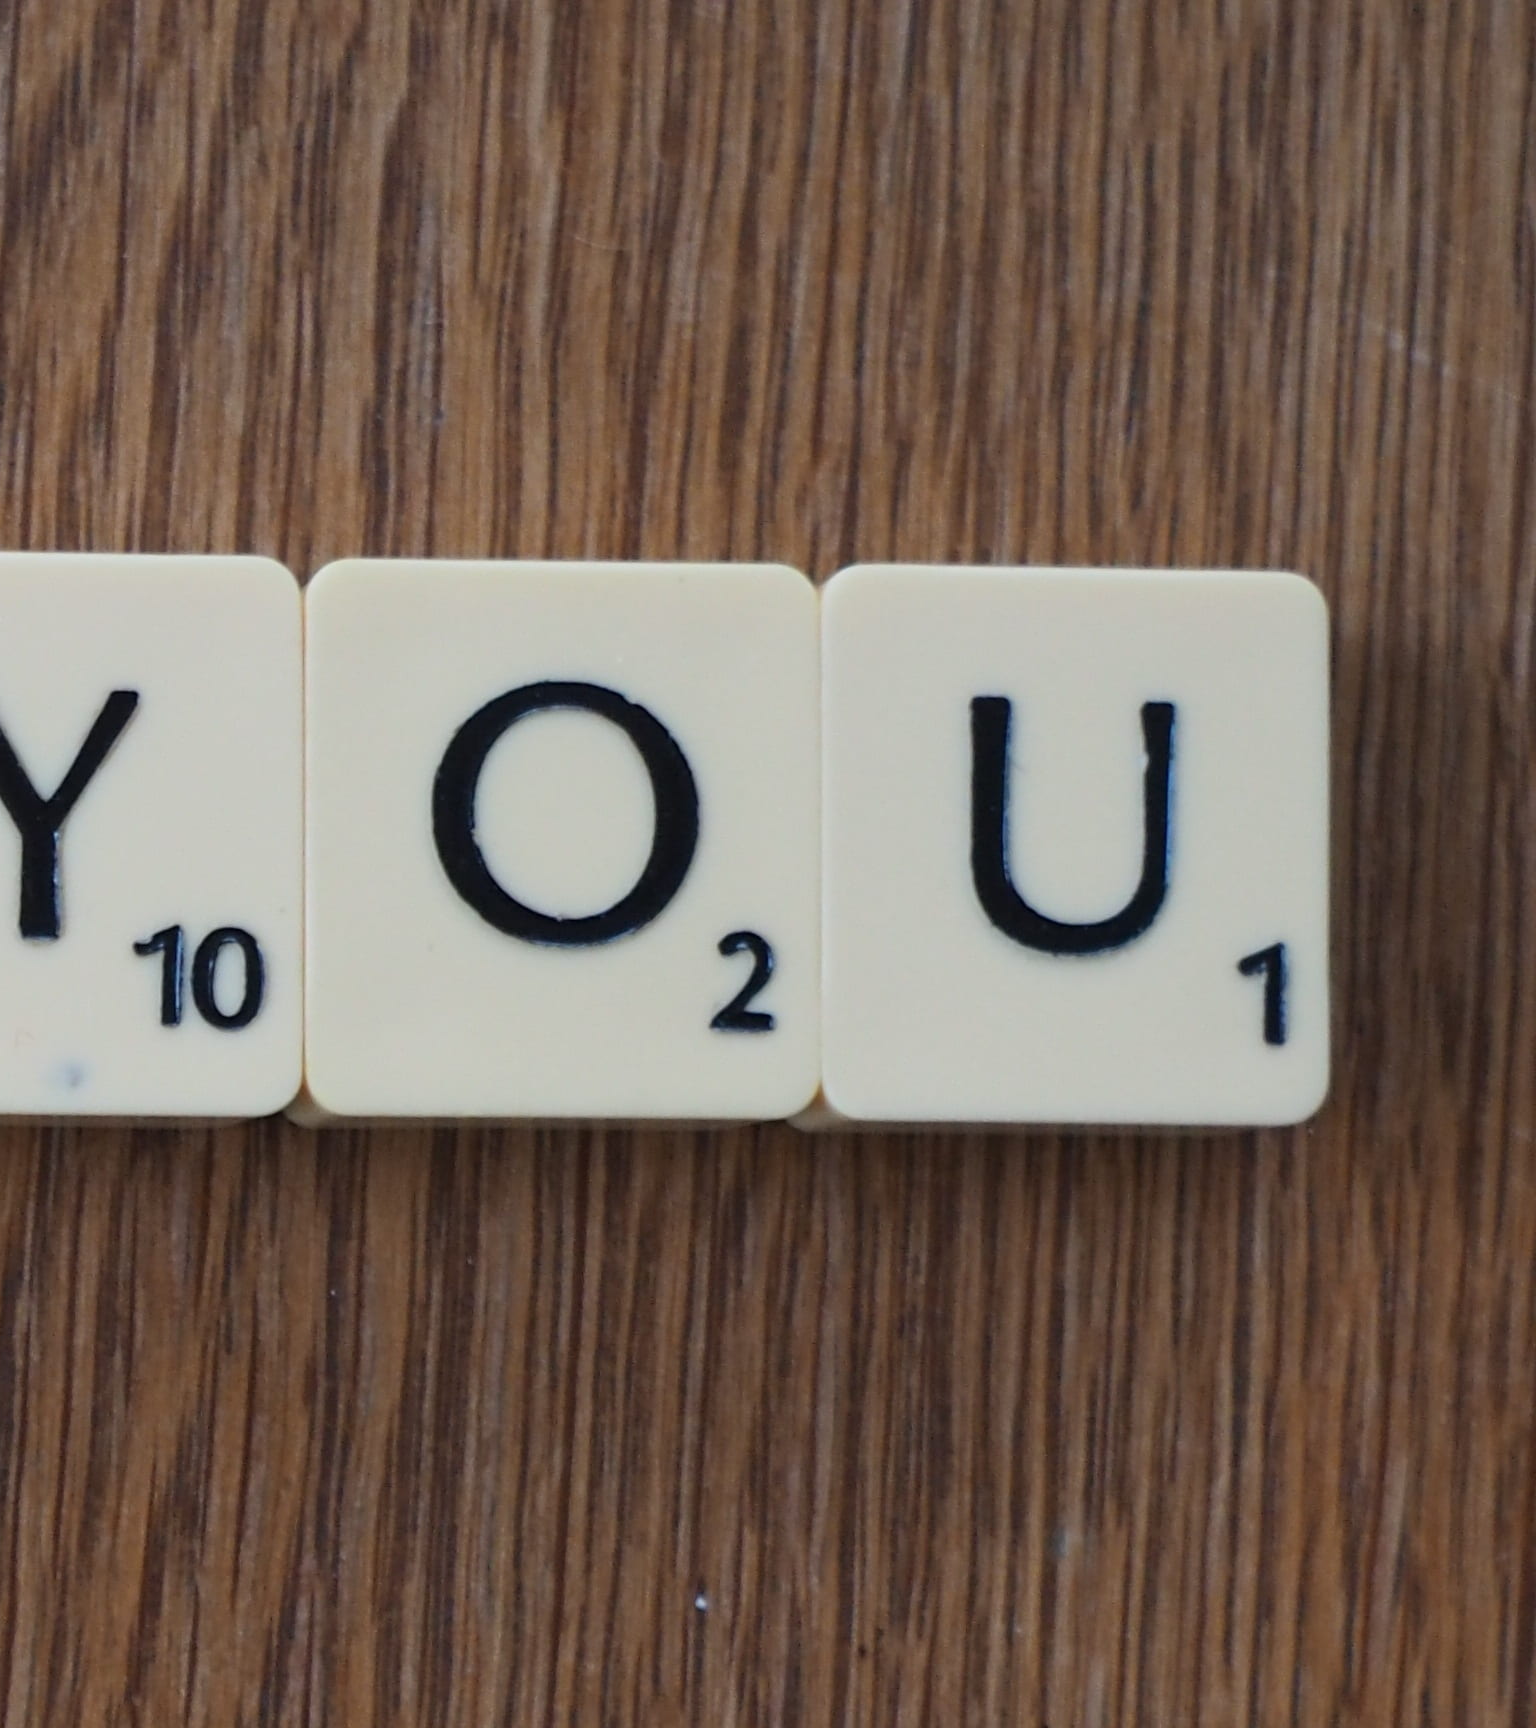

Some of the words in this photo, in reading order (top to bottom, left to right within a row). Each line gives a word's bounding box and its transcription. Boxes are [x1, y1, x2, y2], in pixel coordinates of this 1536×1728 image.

[131, 923, 267, 1032] 10
[708, 929, 777, 1035] 2
[1236, 941, 1290, 1048] 1
